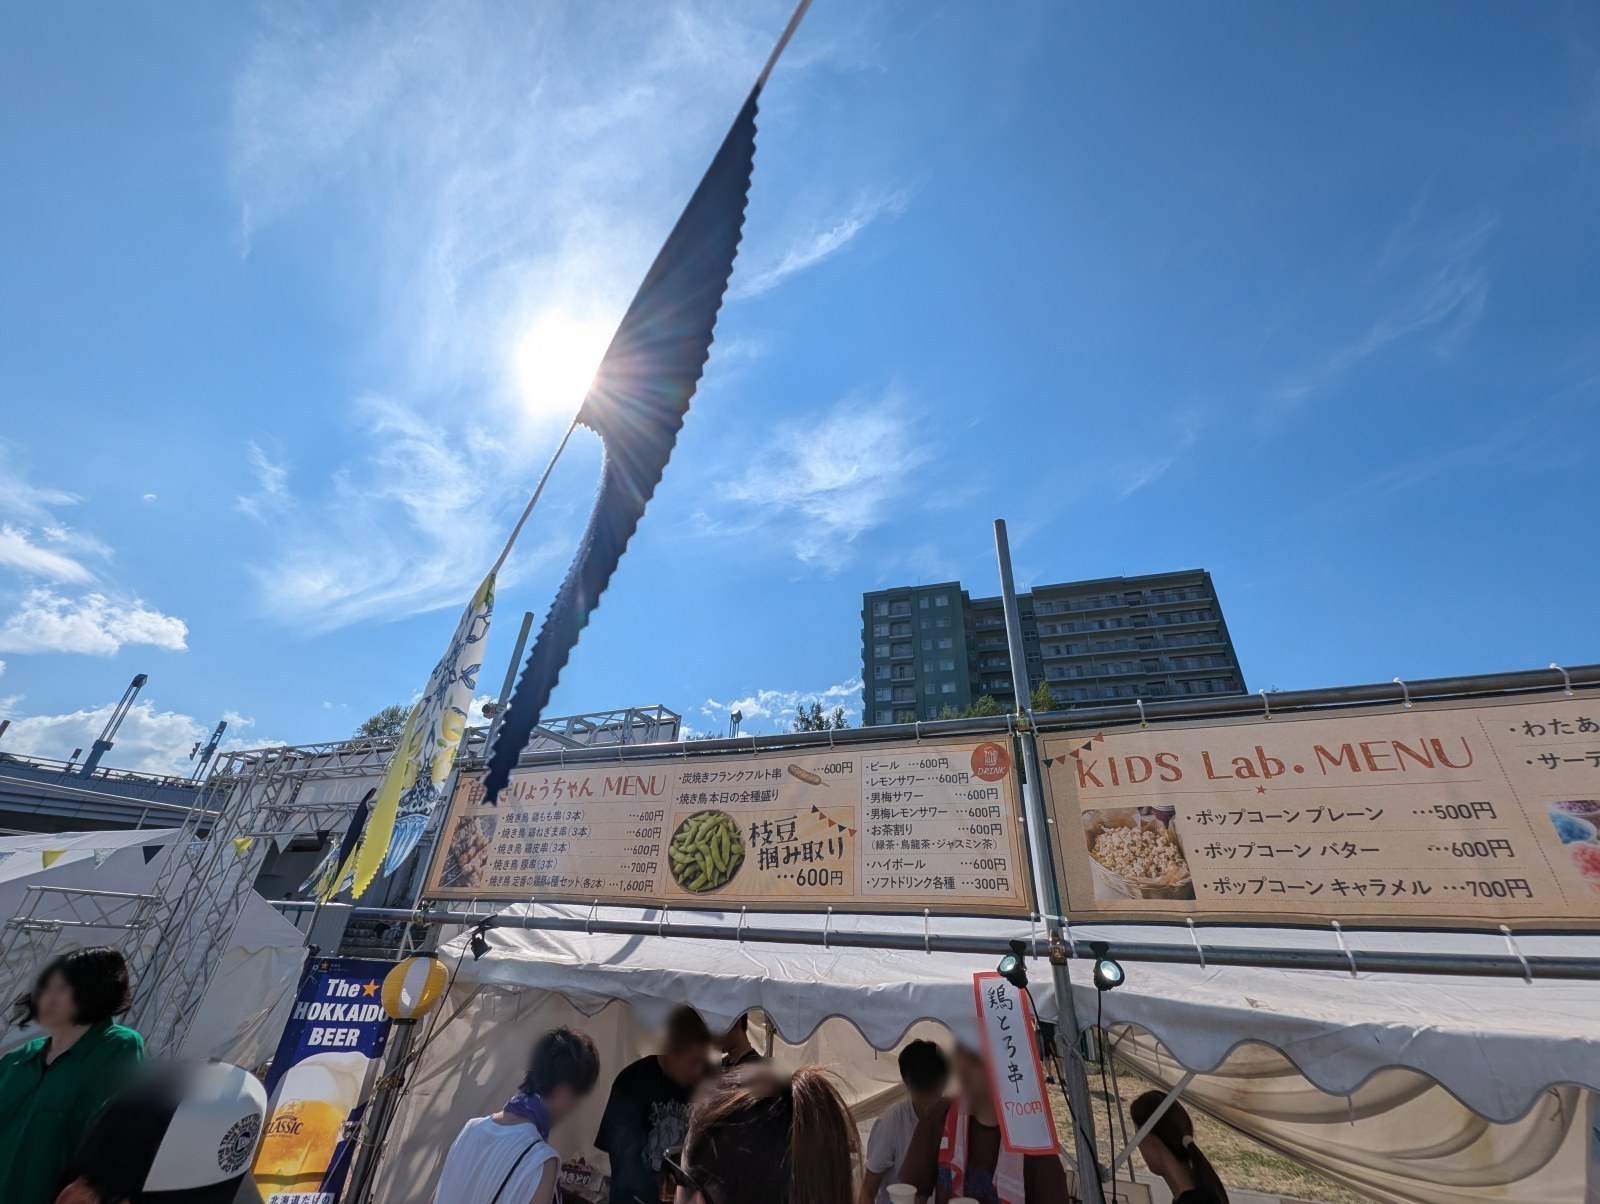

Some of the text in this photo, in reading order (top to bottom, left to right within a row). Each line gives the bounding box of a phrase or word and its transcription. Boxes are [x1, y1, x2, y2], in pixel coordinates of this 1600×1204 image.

[977, 766, 1005, 775] DRINK
[1077, 736, 1473, 788] KIDS Lab. MENU
[603, 775, 667, 797] MENU
[1305, 806, 1384, 824] プレーン
[748, 815, 799, 848] 枝豆
[1320, 842, 1380, 858] バター
[1331, 879, 1431, 896] キャラメル
[326, 978, 361, 998] The
[293, 1001, 390, 1023] HOKKAIDO
[307, 1027, 361, 1047] BEER
[987, 983, 1024, 1094] 鶏とろ串
[1004, 1100, 1043, 1119] 700円
[263, 1120, 304, 1136] CLASSIC
